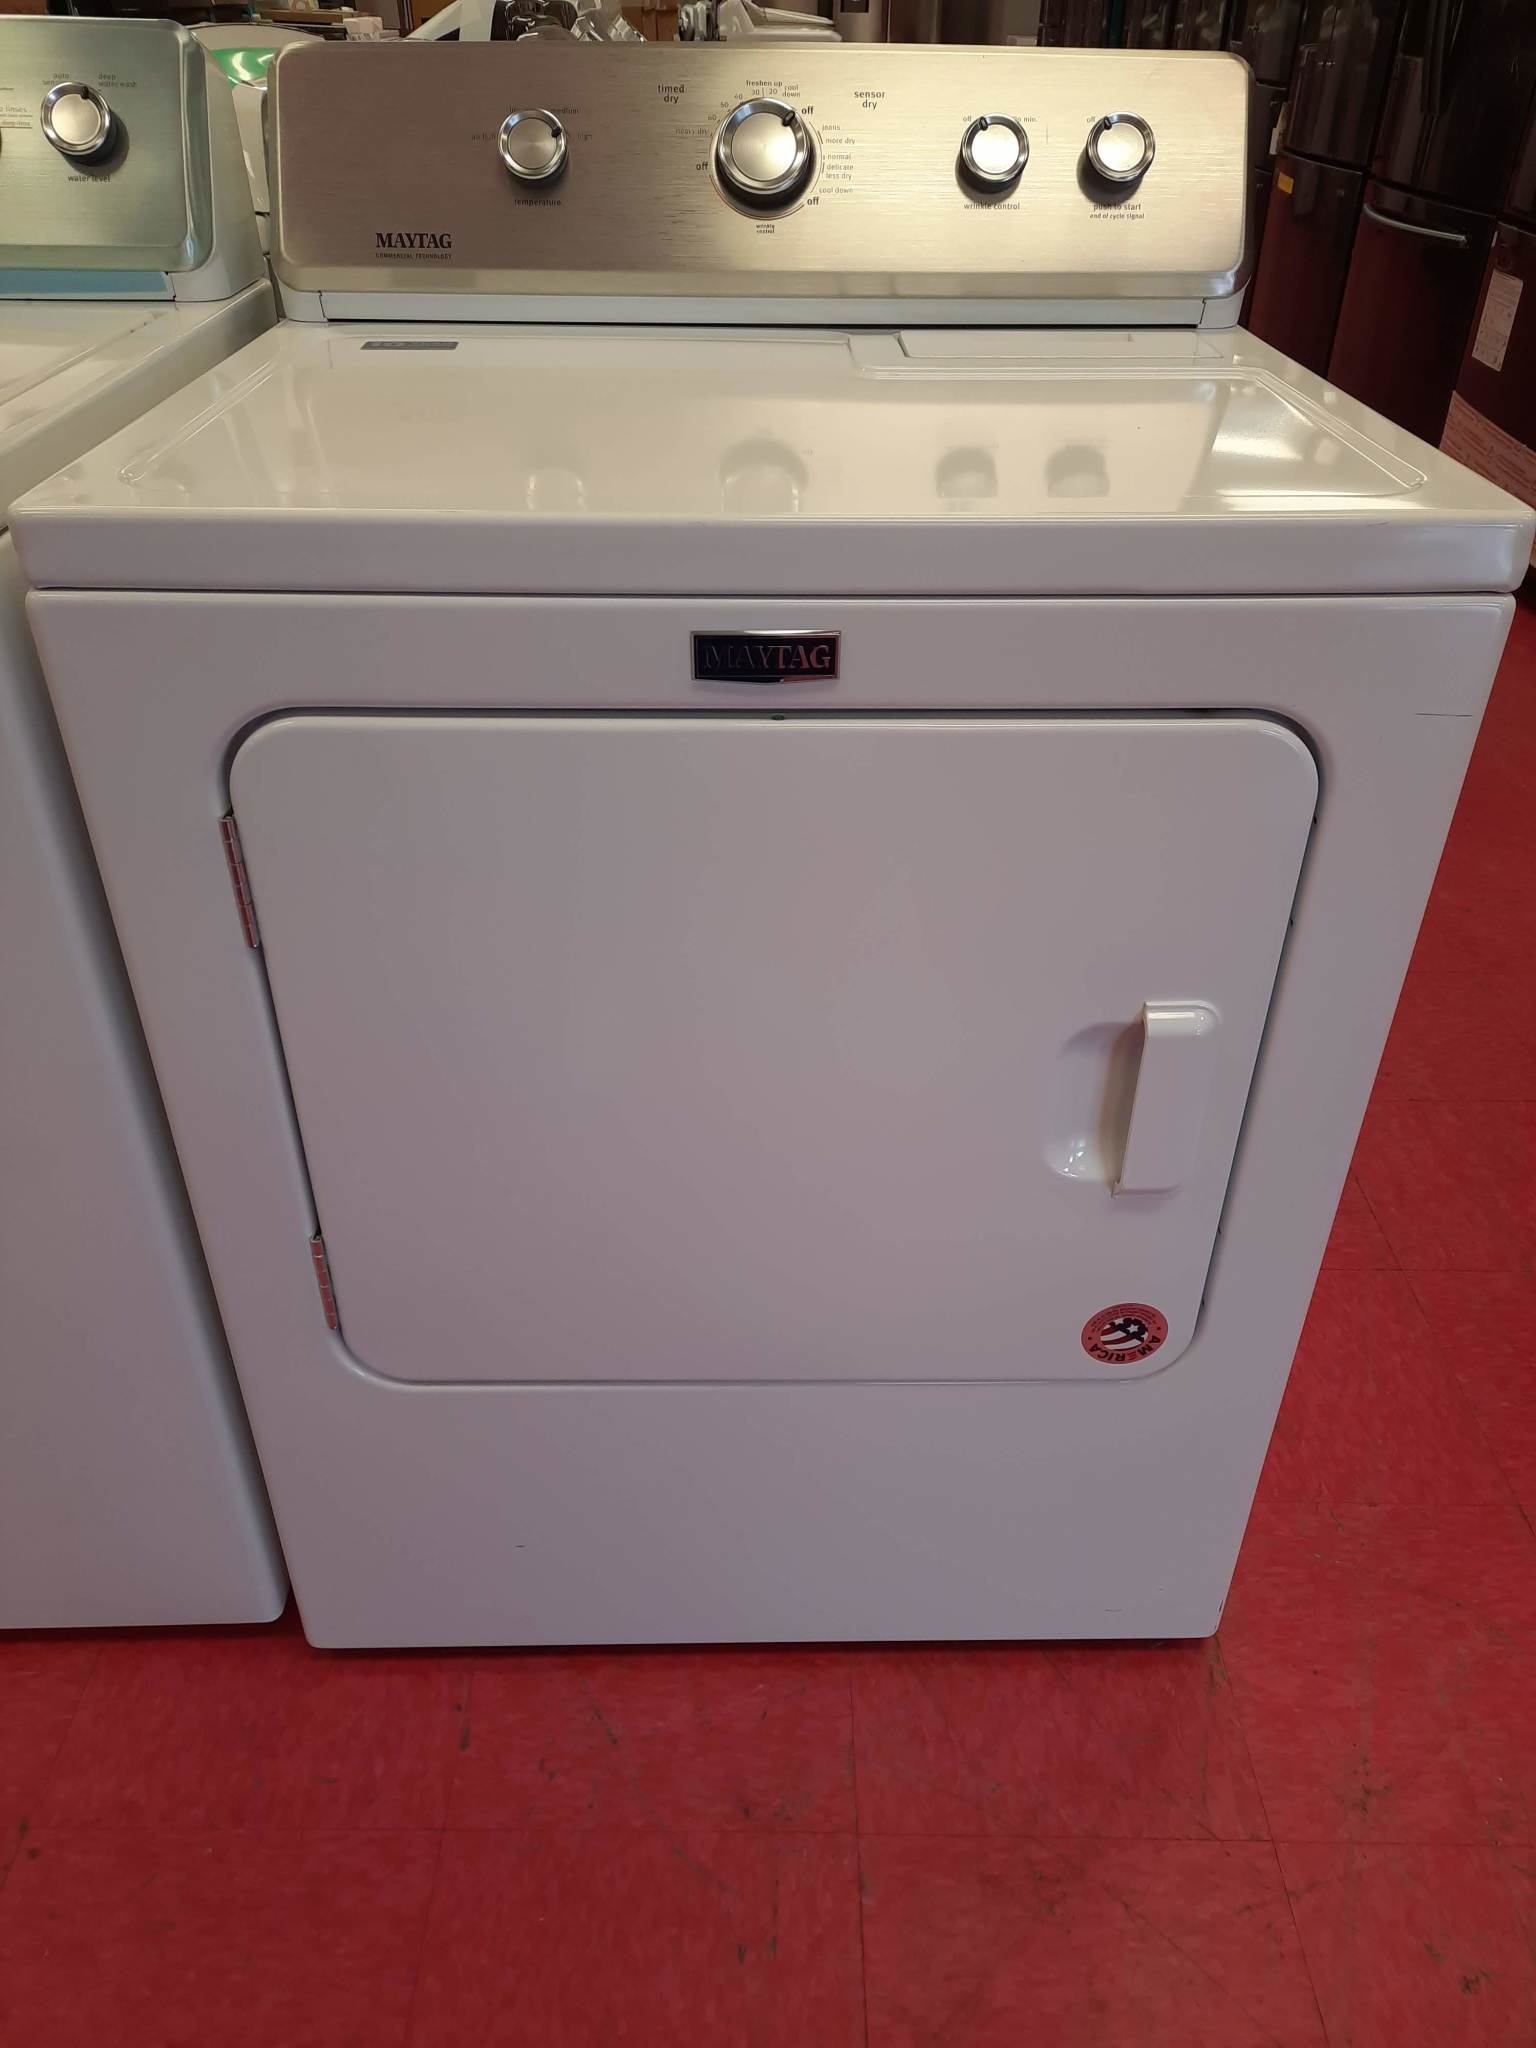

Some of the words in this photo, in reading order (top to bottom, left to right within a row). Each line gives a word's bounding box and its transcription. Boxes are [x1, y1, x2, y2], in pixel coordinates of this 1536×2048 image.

[745, 79, 772, 87] freshen
[773, 80, 783, 88] up
[657, 84, 685, 93] timed
[853, 90, 886, 98] sensor
[663, 94, 679, 104] dry
[862, 99, 877, 109] dry
[801, 106, 814, 115] off
[1086, 115, 1096, 123] off
[844, 136, 856, 145] dry
[827, 152, 852, 160] normal
[695, 162, 709, 171] off
[826, 163, 854, 171] delicate
[91, 174, 111, 183] level
[841, 172, 852, 181] dry
[819, 186, 834, 194] cool
[834, 186, 854, 194] down
[514, 199, 561, 208] temperature
[806, 196, 819, 206] off
[963, 202, 992, 210] wrinkle
[993, 202, 1020, 210] control
[1093, 203, 1113, 212] push
[1114, 203, 1121, 211] to
[1123, 203, 1141, 211] start
[1109, 212, 1125, 220] cycle
[1126, 212, 1145, 220] signal
[375, 232, 452, 249] MAYTAG
[703, 644, 831, 669] MAYTAG
[1088, 1334, 1161, 1362] AMERICA
